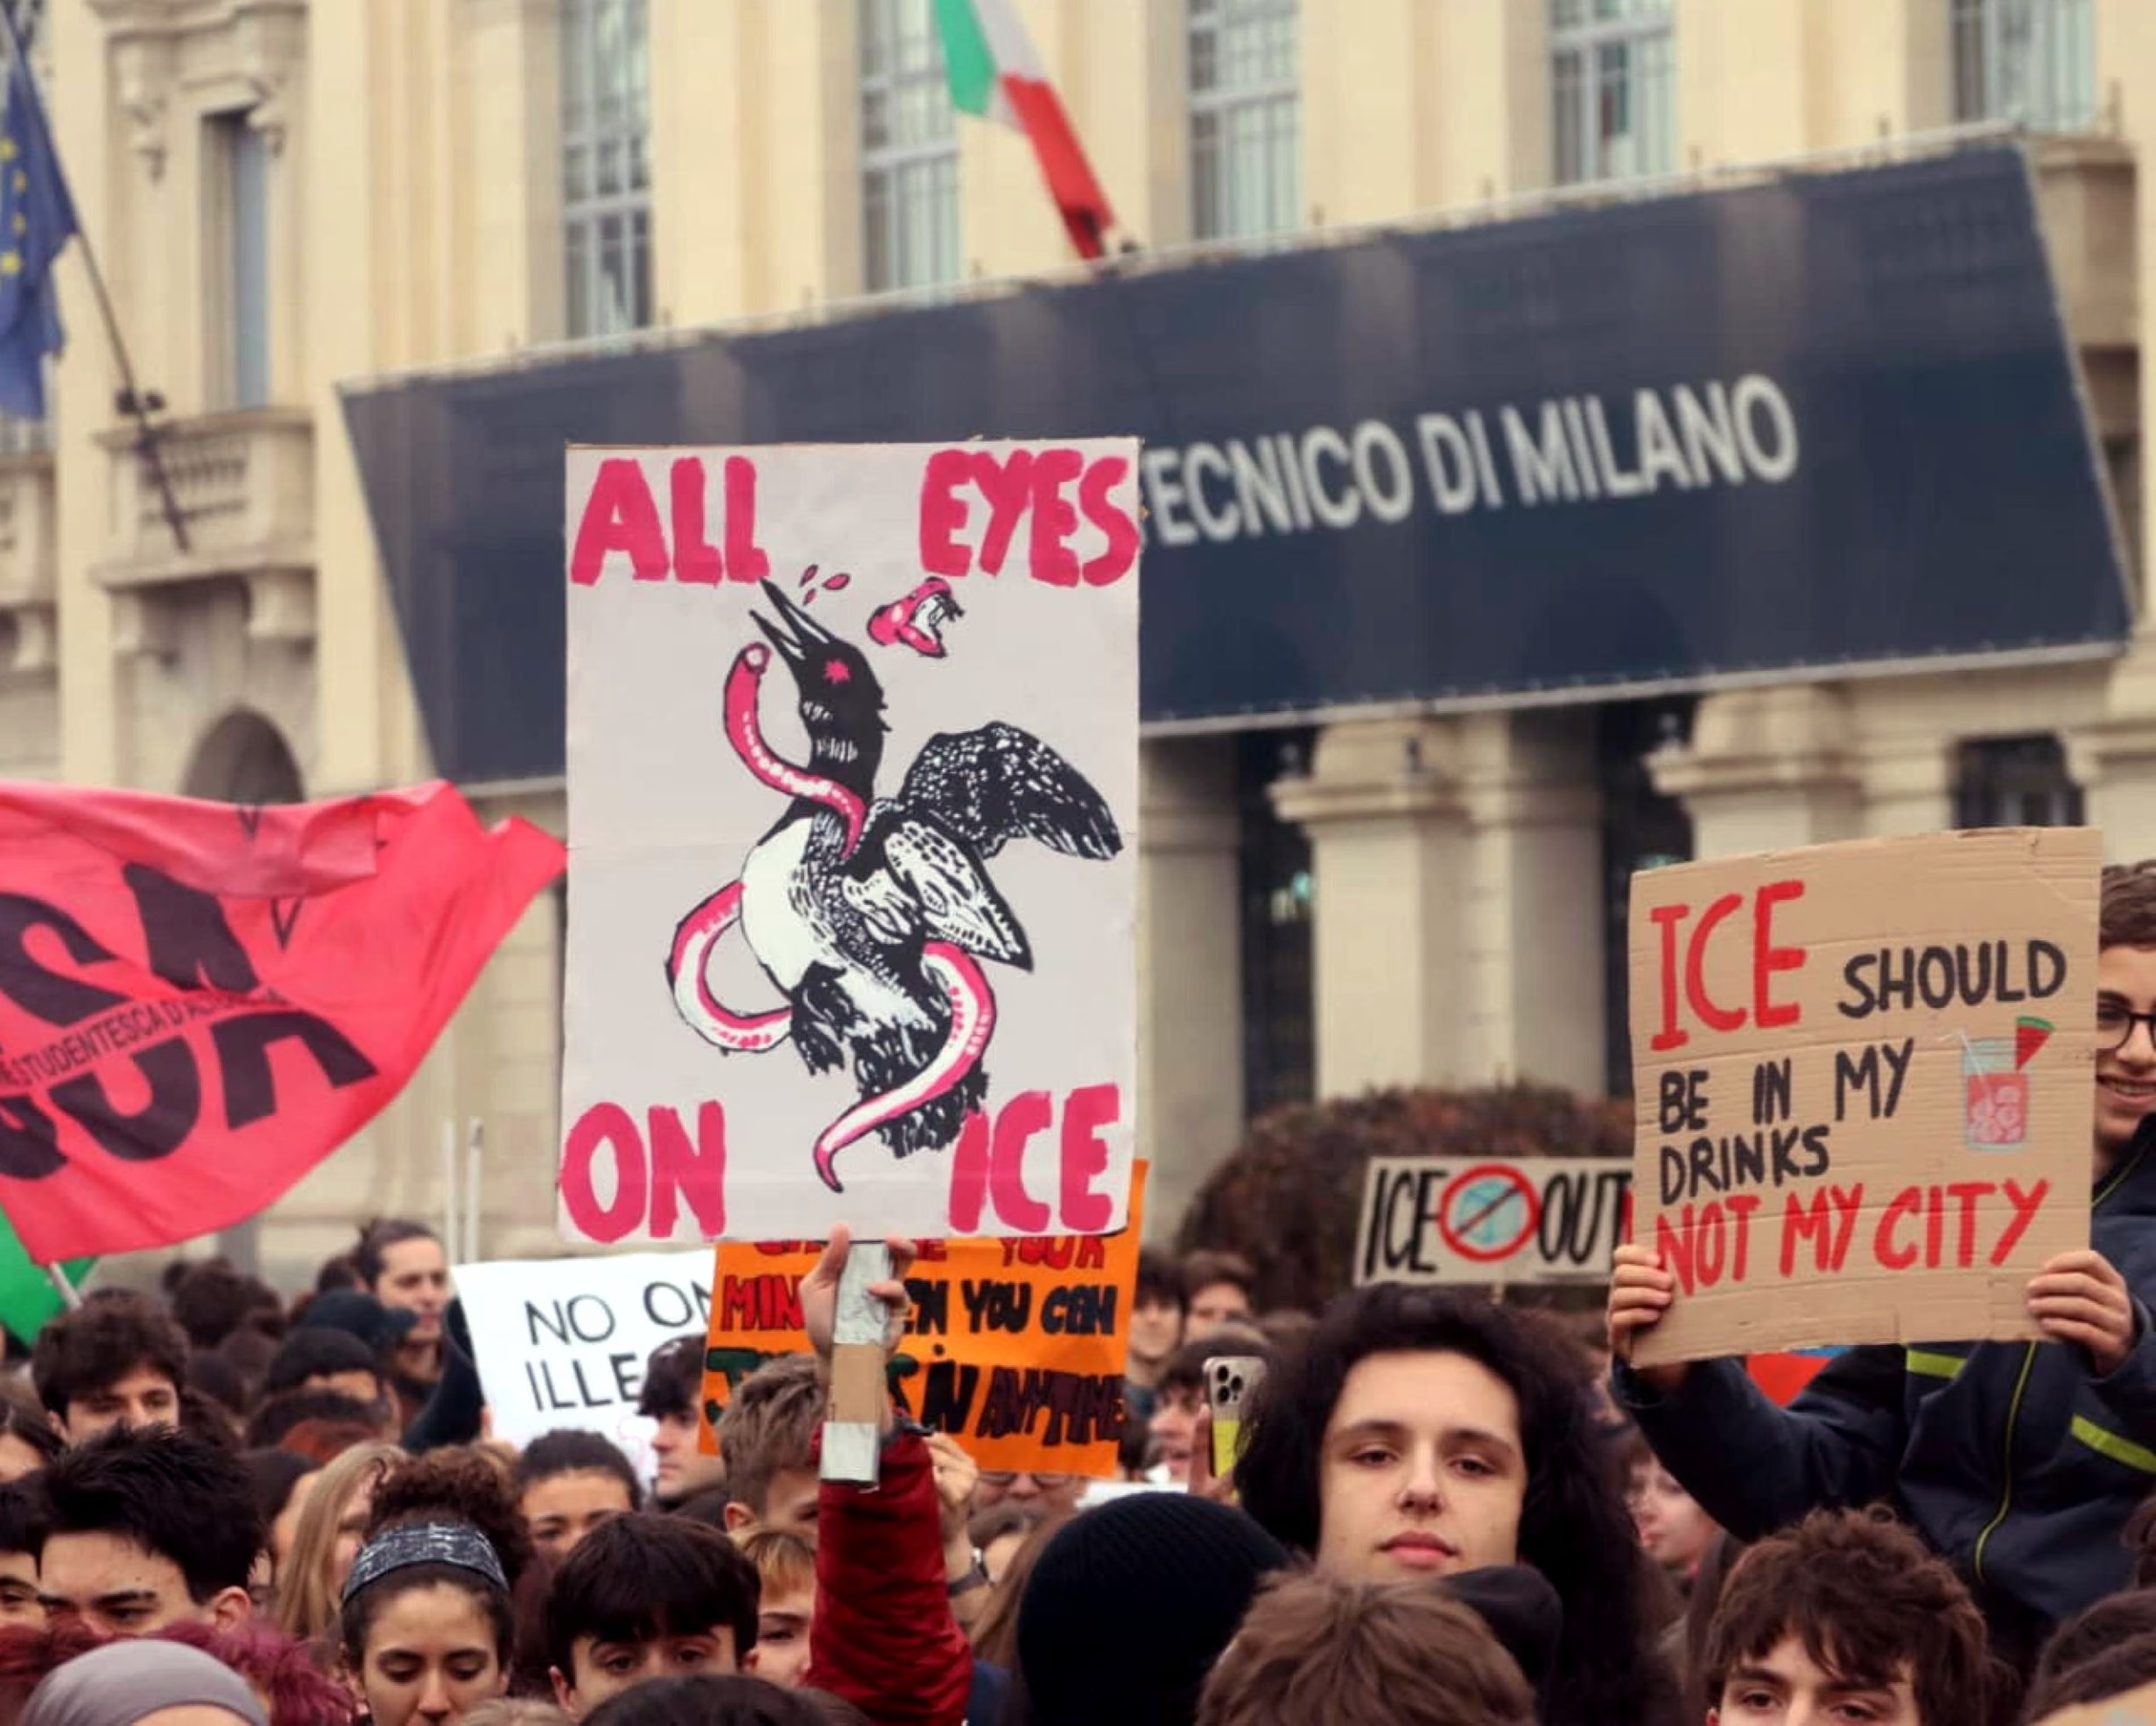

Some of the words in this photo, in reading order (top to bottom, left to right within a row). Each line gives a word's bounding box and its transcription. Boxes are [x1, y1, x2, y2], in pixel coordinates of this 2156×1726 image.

[1140, 418, 1414, 548] ECNICO
[1417, 411, 1505, 515] DI
[1499, 372, 1800, 507] MILANO
[571, 456, 769, 585] ALL
[919, 448, 1138, 587] EYES
[1650, 880, 1806, 1051] ICE
[1838, 940, 2067, 1019] SHOULD
[1660, 1070, 1709, 1134] BE
[1753, 1058, 1791, 1124] IN
[1835, 1038, 1913, 1121] MY
[560, 1099, 726, 1243] ON
[948, 1083, 1120, 1232] ICE
[1661, 1125, 1830, 1205] DRINKS
[1365, 1169, 1448, 1276] ICE
[1538, 1171, 1633, 1271] OUT
[1657, 1195, 1761, 1297] NOT
[1779, 1183, 1863, 1277] MY
[1874, 1178, 2048, 1270] CITY
[525, 1293, 616, 1346] NO
[721, 1274, 806, 1331] MIN
[962, 1279, 1031, 1332] YOU
[1040, 1285, 1117, 1334] CAN
[525, 1352, 641, 1412] ILLE
